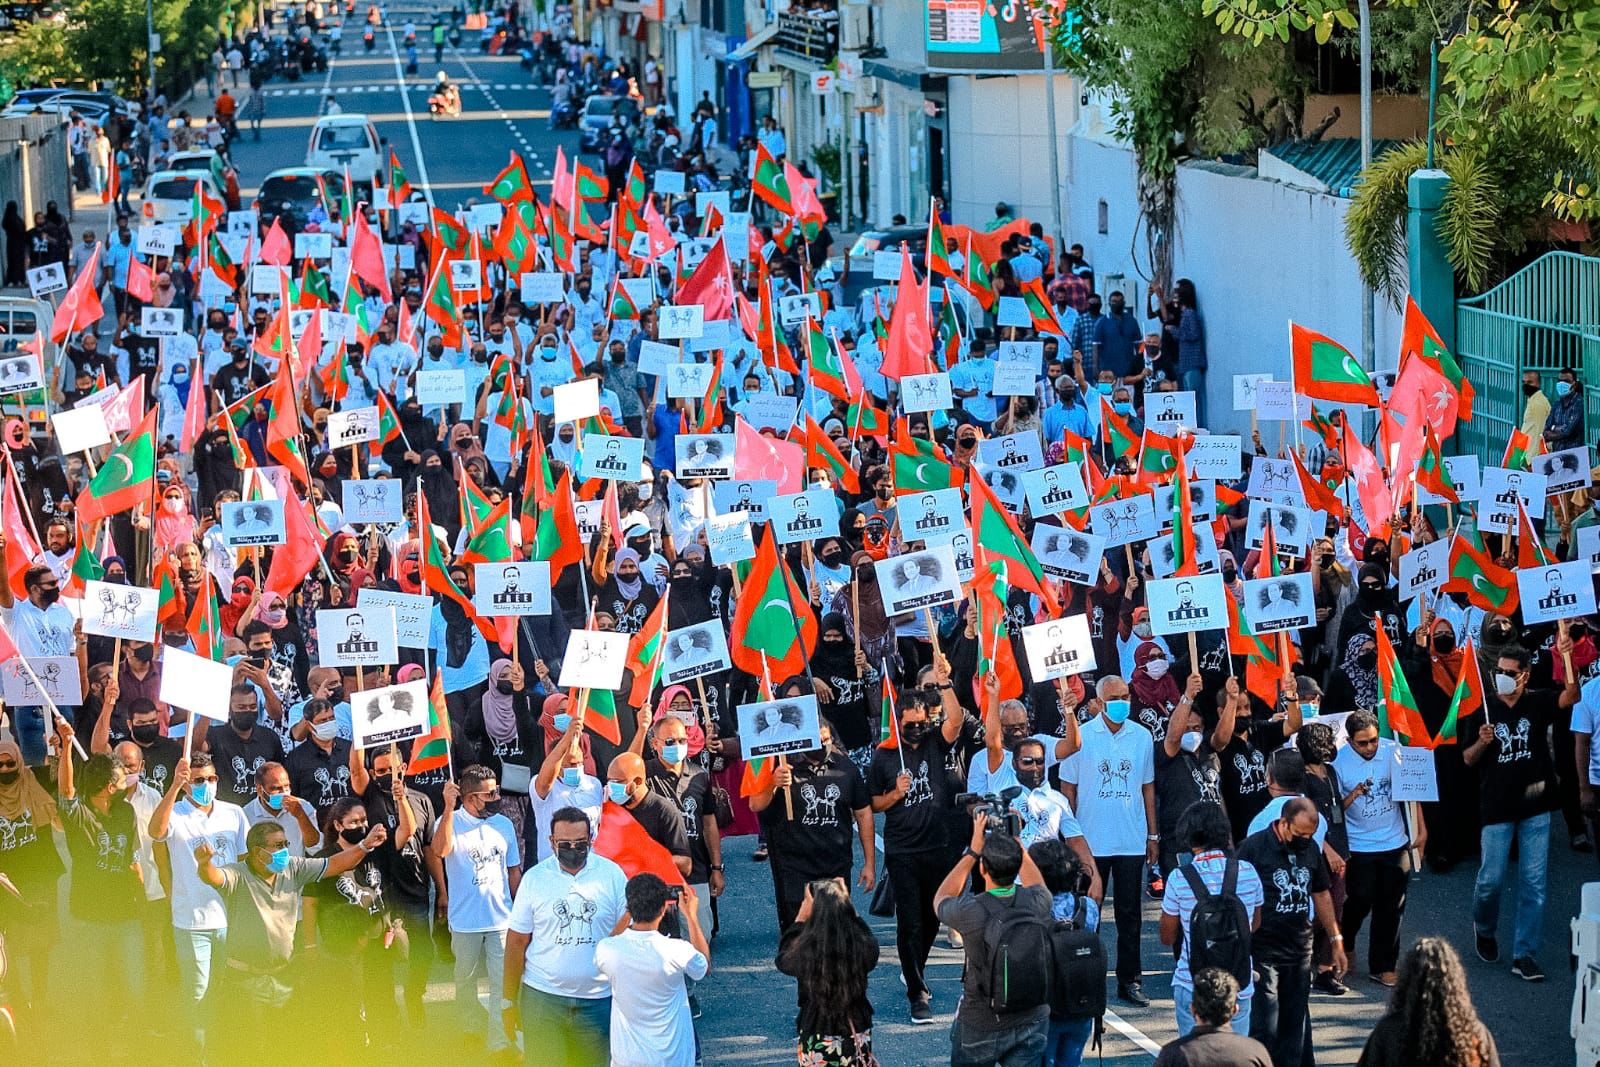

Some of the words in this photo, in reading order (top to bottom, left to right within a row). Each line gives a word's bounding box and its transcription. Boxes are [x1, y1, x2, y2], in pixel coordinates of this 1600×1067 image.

[790, 520, 820, 530] FREE
[496, 594, 530, 603] FREE
[1542, 594, 1575, 607] FREE
[1171, 608, 1206, 620] FREE
[339, 642, 376, 653] FREE
[1045, 652, 1077, 667] FREE
